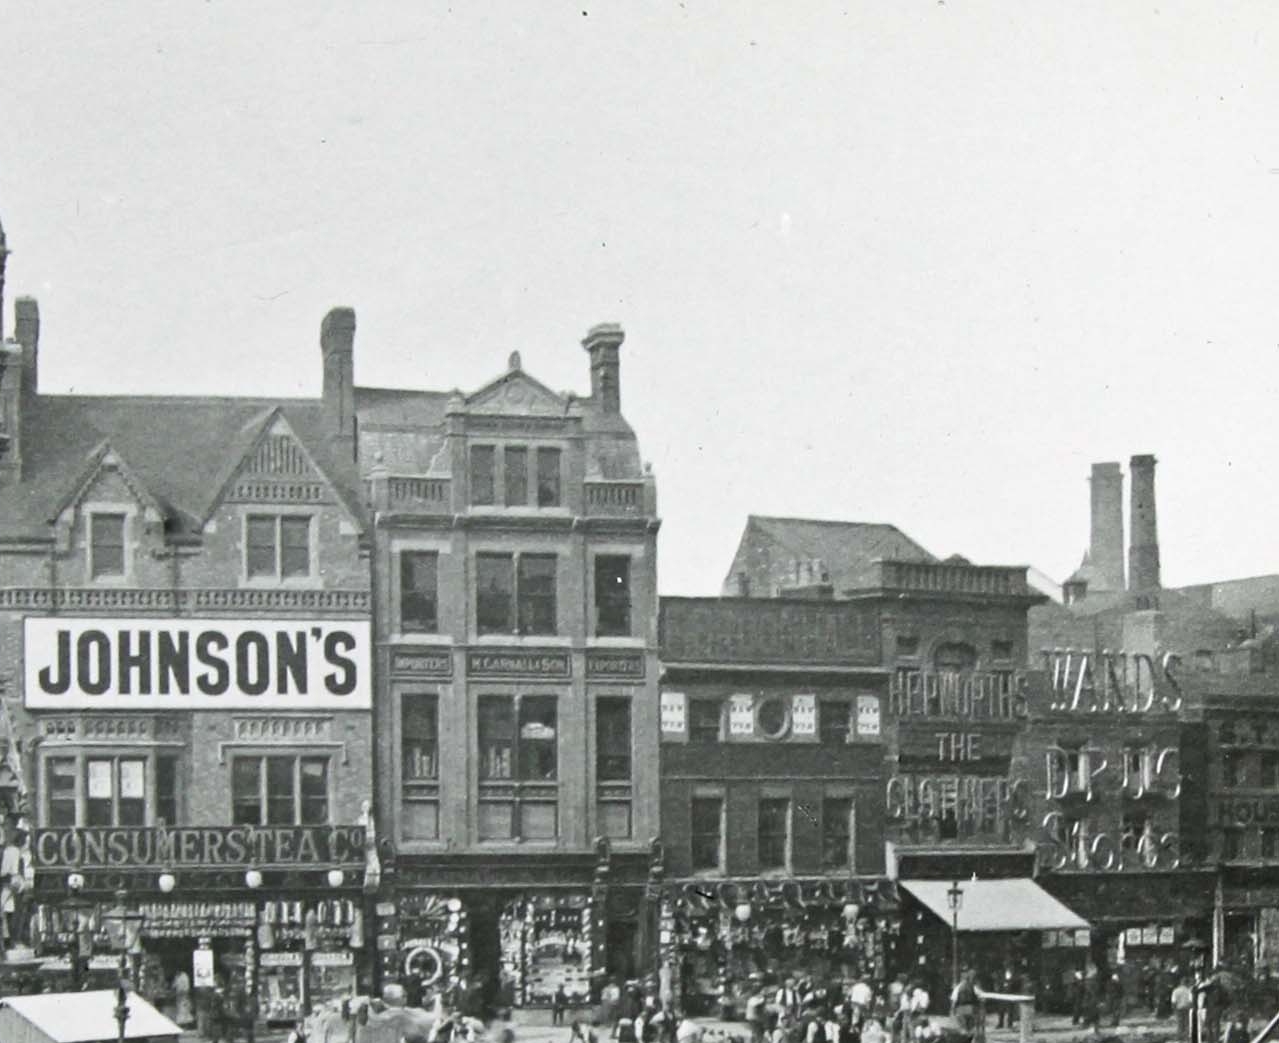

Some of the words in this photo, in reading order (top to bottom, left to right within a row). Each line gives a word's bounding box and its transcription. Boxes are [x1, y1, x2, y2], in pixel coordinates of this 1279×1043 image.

[38, 626, 358, 696] JOHNSON'S
[936, 732, 981, 761] THE
[252, 828, 319, 863] TEA
